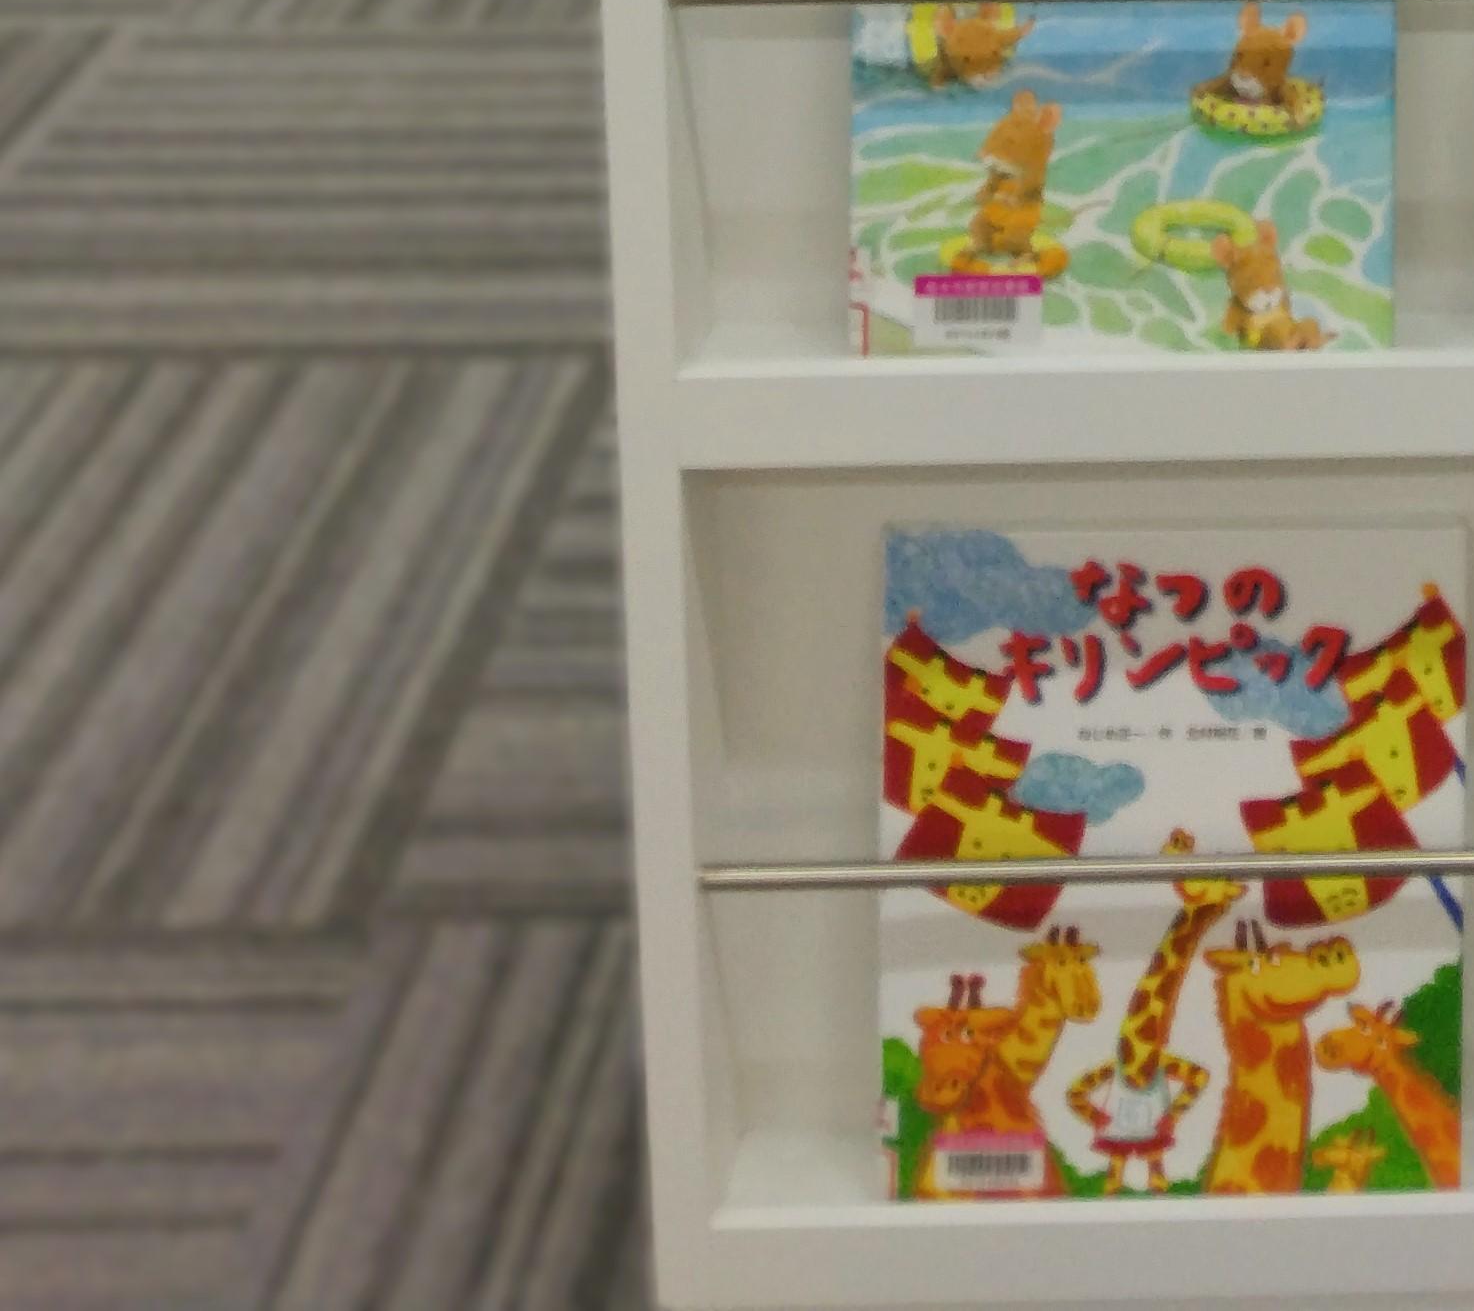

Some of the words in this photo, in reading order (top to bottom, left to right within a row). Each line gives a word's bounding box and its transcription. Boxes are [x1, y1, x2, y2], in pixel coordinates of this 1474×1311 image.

[1070, 559, 1284, 625] なつの
[1001, 621, 1349, 704] キリンピック
